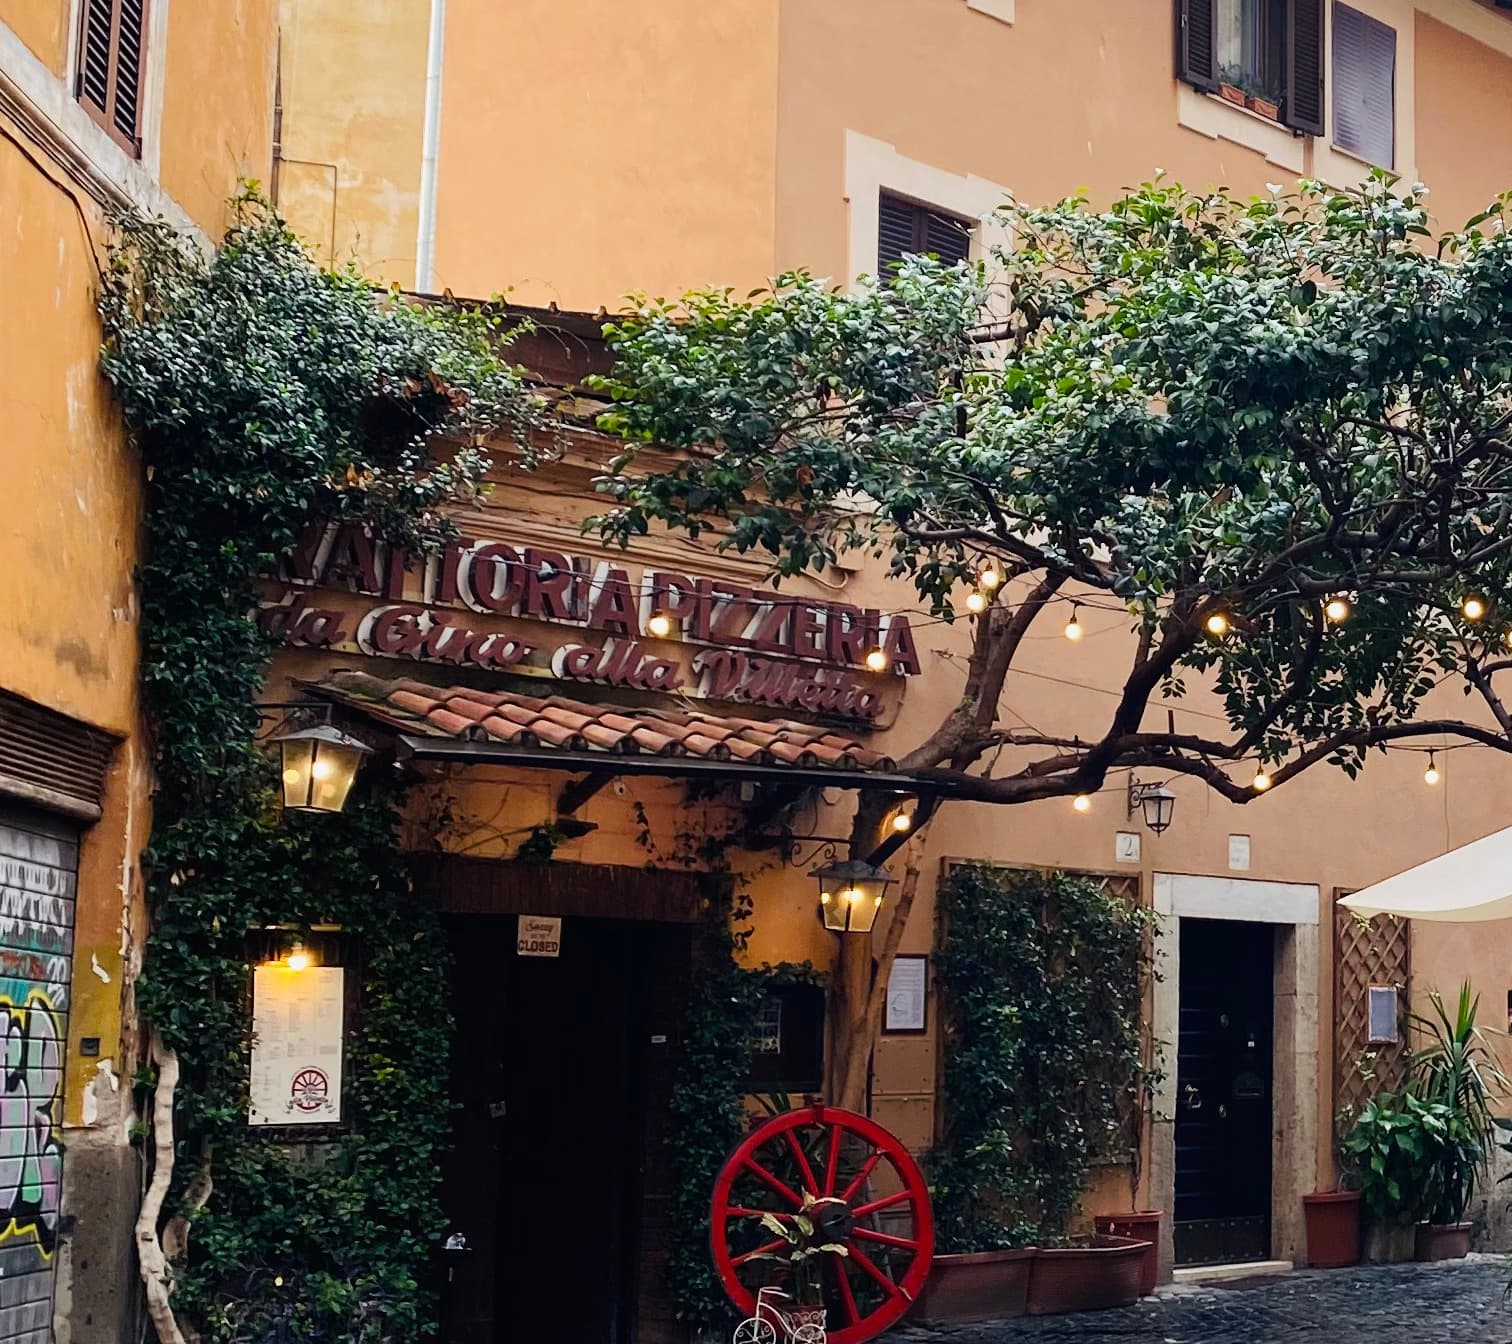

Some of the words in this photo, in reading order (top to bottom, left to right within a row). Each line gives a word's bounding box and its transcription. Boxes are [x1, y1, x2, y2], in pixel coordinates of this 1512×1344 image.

[260, 589, 346, 646] da
[366, 605, 537, 667] Gino
[562, 636, 684, 691] alla
[694, 649, 884, 716] Villetta
[646, 571, 921, 675] PIZZERIA
[519, 940, 558, 953] CLOSED
